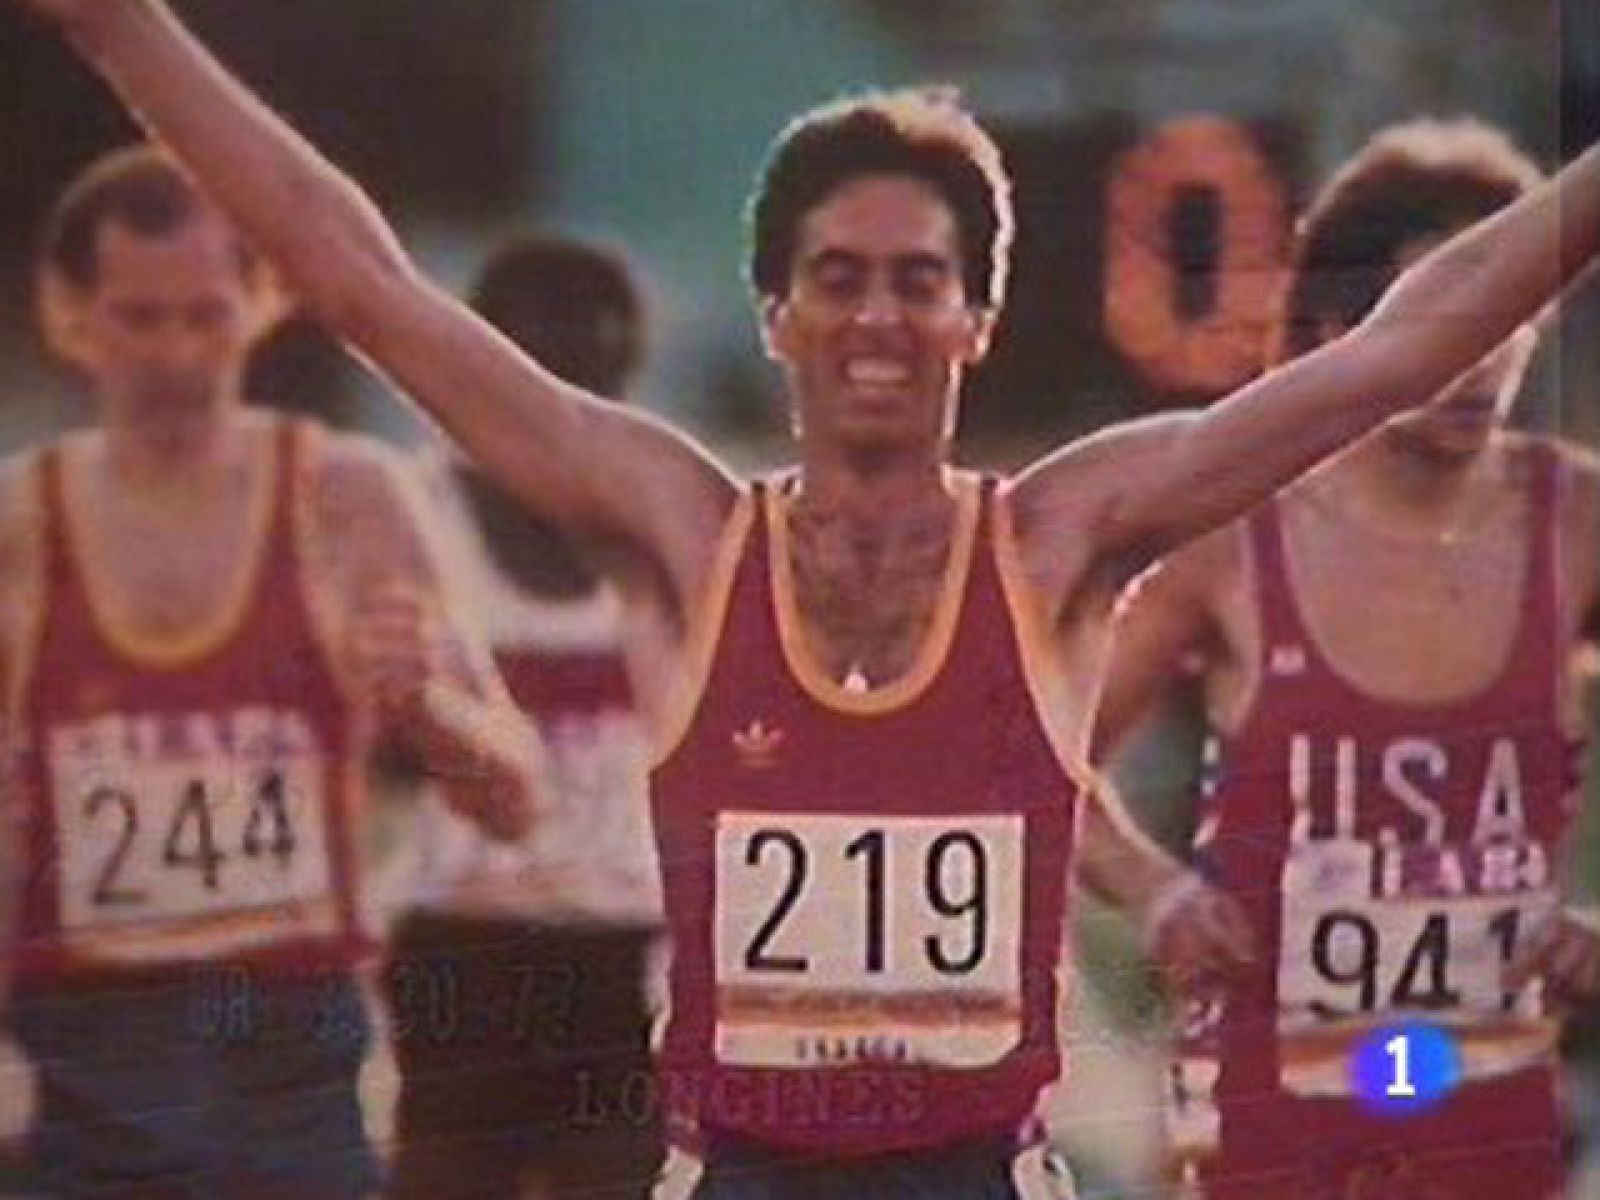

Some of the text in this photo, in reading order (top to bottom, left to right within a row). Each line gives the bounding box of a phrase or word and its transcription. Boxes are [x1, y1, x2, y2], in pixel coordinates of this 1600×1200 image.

[82, 772, 297, 905] 244
[1289, 735, 1527, 848] USA
[745, 829, 987, 975] 219
